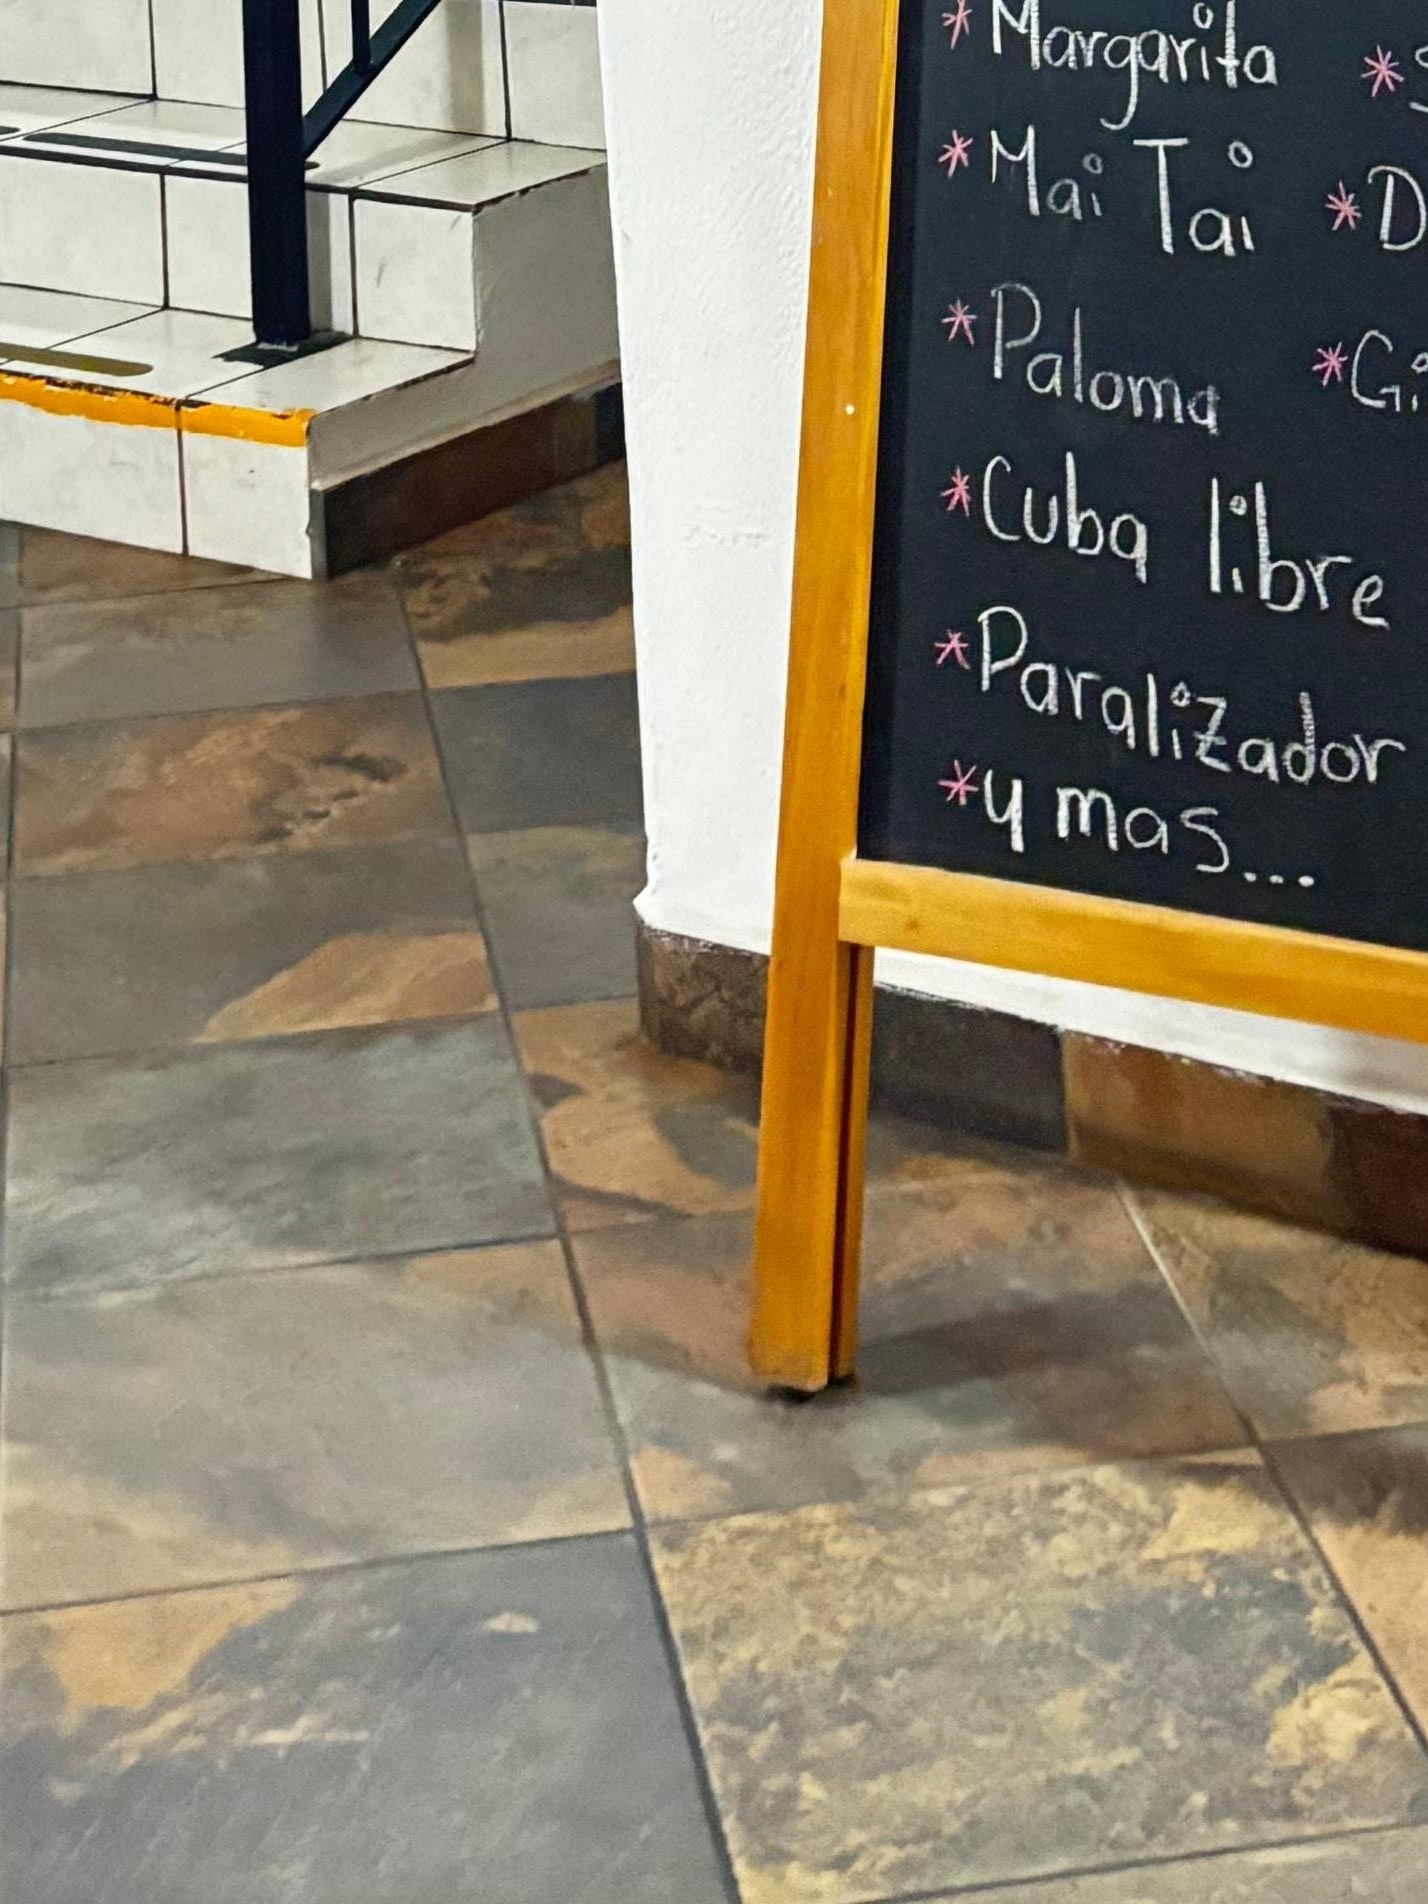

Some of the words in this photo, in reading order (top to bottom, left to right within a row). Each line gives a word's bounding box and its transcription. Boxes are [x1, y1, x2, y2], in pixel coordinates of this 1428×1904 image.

[990, 123, 1104, 222] Mai
[1132, 136, 1256, 257] Tai
[990, 282, 1220, 437] Paloma
[981, 450, 1150, 584] Cuba
[1207, 476, 1392, 631] libre
[975, 603, 1408, 787] Paralizador
